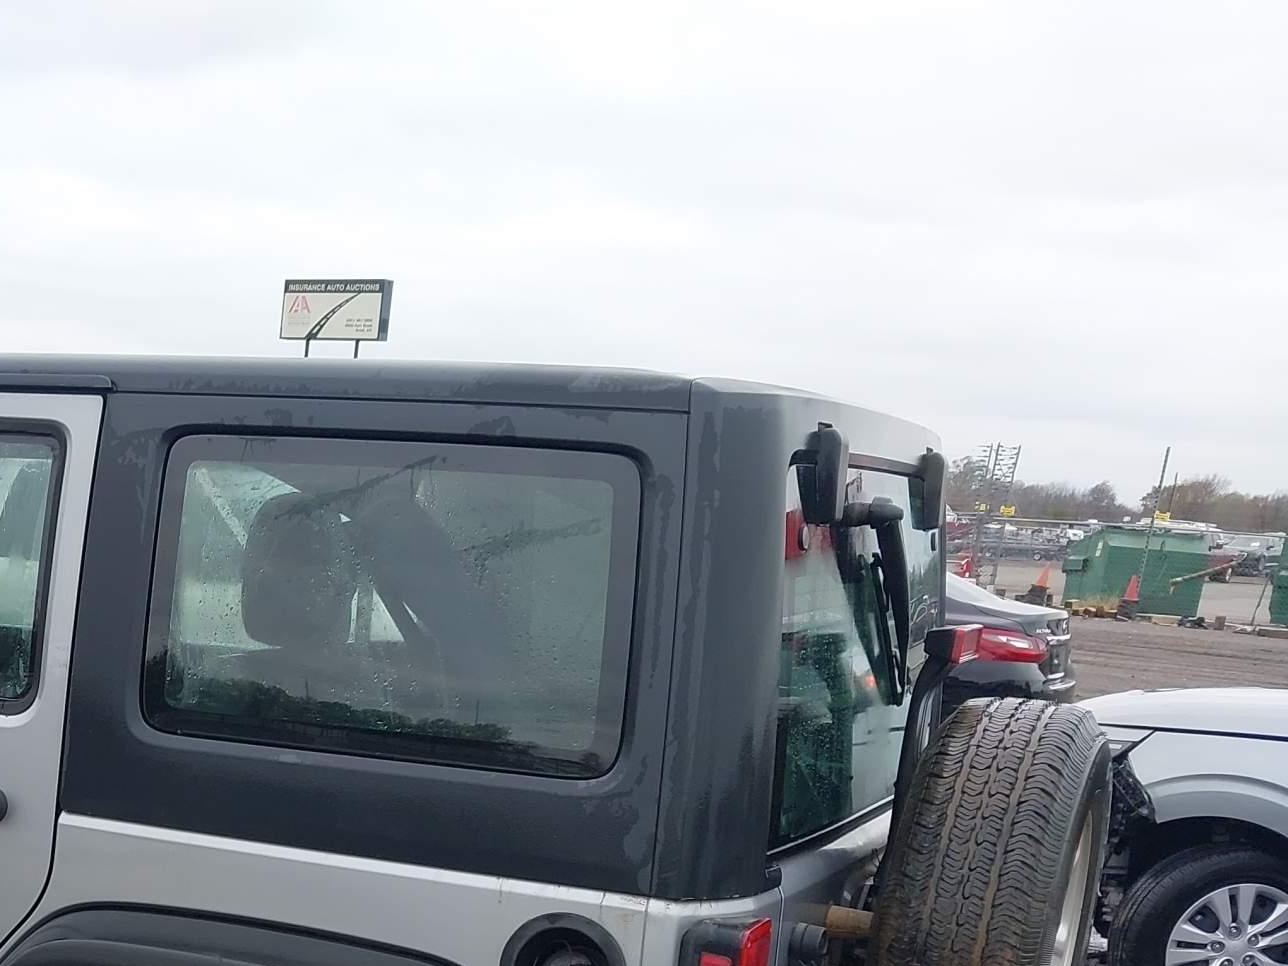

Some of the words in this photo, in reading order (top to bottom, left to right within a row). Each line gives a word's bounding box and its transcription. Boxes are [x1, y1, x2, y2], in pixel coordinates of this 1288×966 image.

[288, 283, 326, 292] INSURANCE
[326, 283, 345, 292] AUTO
[345, 283, 380, 292] AUCTIONS
